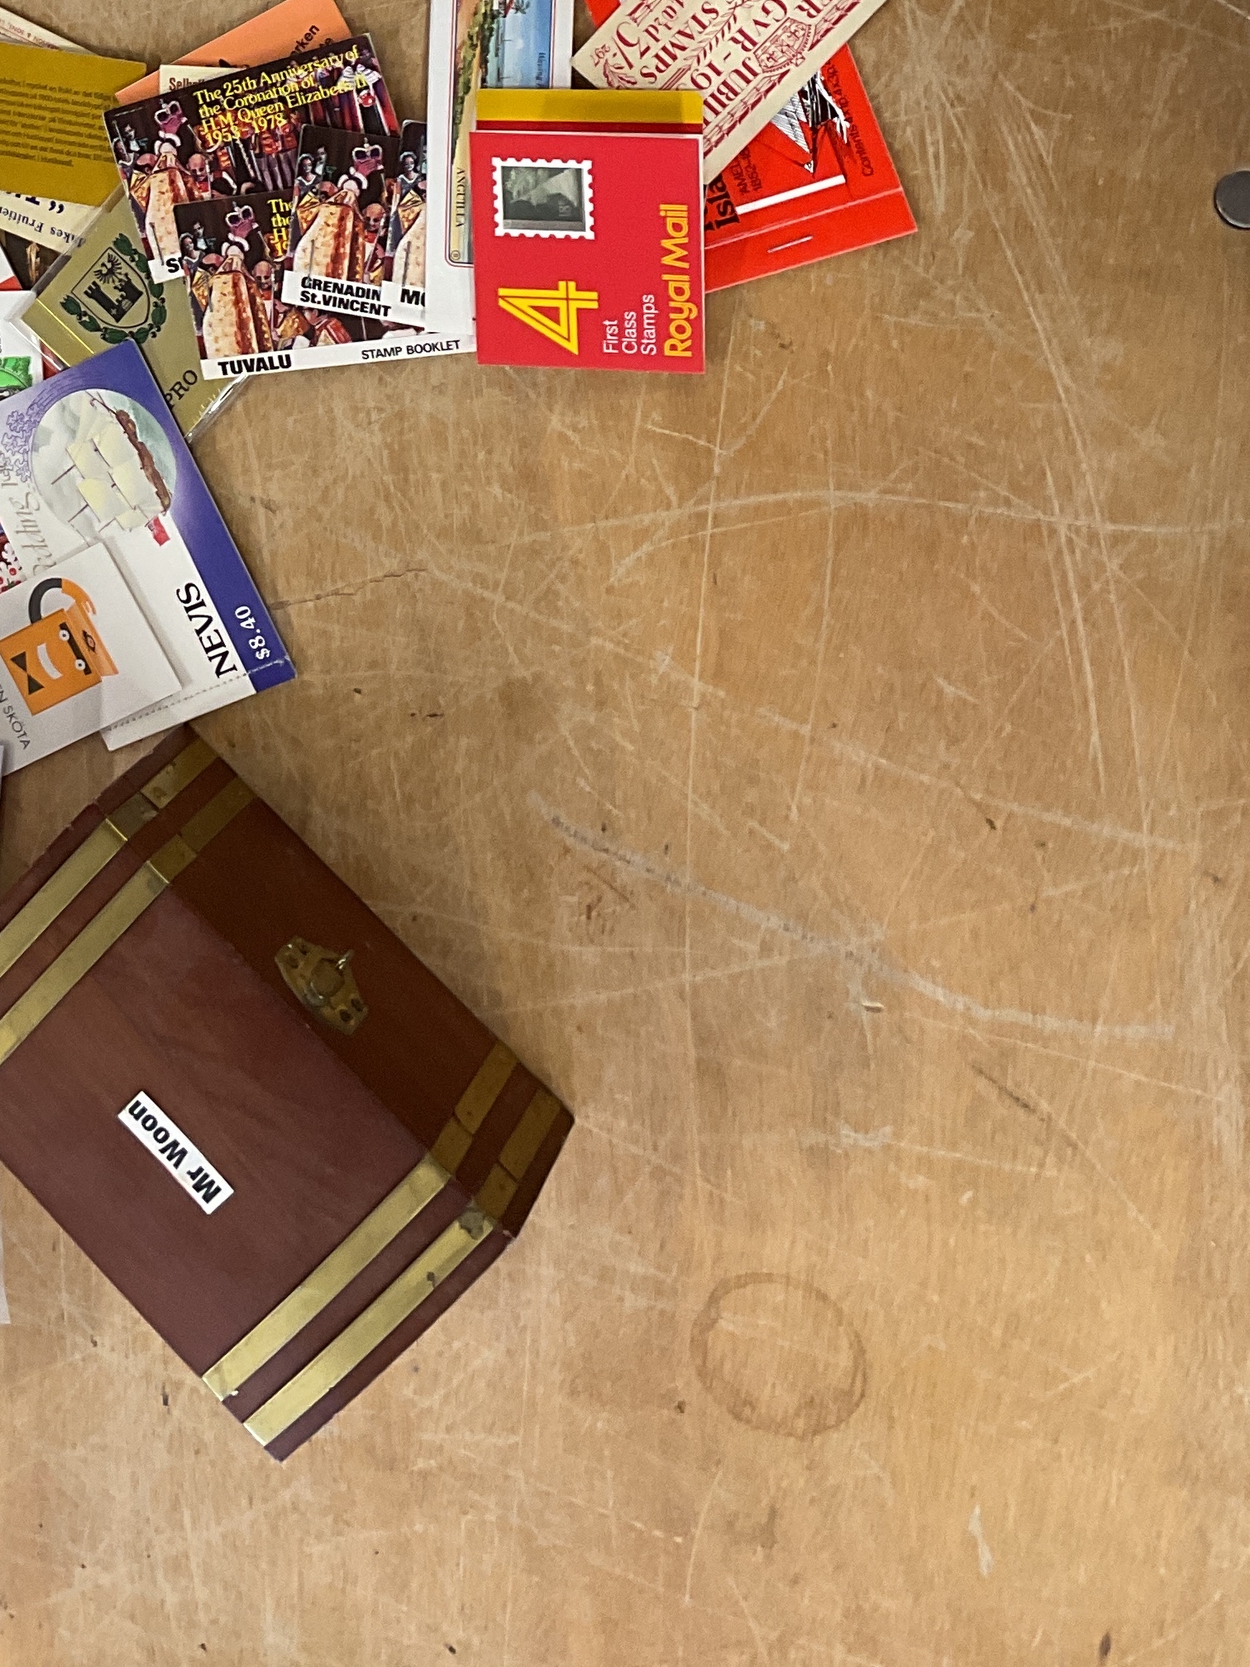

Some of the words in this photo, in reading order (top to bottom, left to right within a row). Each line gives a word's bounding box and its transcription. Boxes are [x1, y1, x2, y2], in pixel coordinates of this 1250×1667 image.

[593, 45, 612, 68] 297
[640, 2, 719, 85] STAMPS
[193, 88, 221, 105] The
[223, 80, 257, 97] 25th
[260, 56, 344, 85] Anniversary
[345, 45, 359, 61] of
[198, 104, 220, 119] the
[222, 80, 298, 112] Coronation
[301, 73, 315, 89] of
[205, 125, 241, 148] 1953
[252, 113, 287, 134] 1978
[237, 99, 285, 124] Queen
[286, 84, 355, 109] Elizabeth
[847, 123, 874, 177] Contents
[455, 166, 465, 228] ANGUILLA
[660, 204, 689, 269] Mail
[300, 276, 381, 302] GRENADIN
[662, 274, 698, 358] Royal
[498, 280, 599, 356] 4
[603, 319, 619, 354] First
[622, 311, 638, 354] Class
[640, 294, 658, 355] Stamps
[218, 354, 292, 376] TUVALU
[361, 346, 402, 361] STAMP
[405, 338, 461, 357] BOOKLET
[175, 582, 237, 679] NEVIS
[234, 605, 270, 662] $8.40
[128, 1099, 188, 1170] Woon
[186, 1166, 222, 1204] Mr
